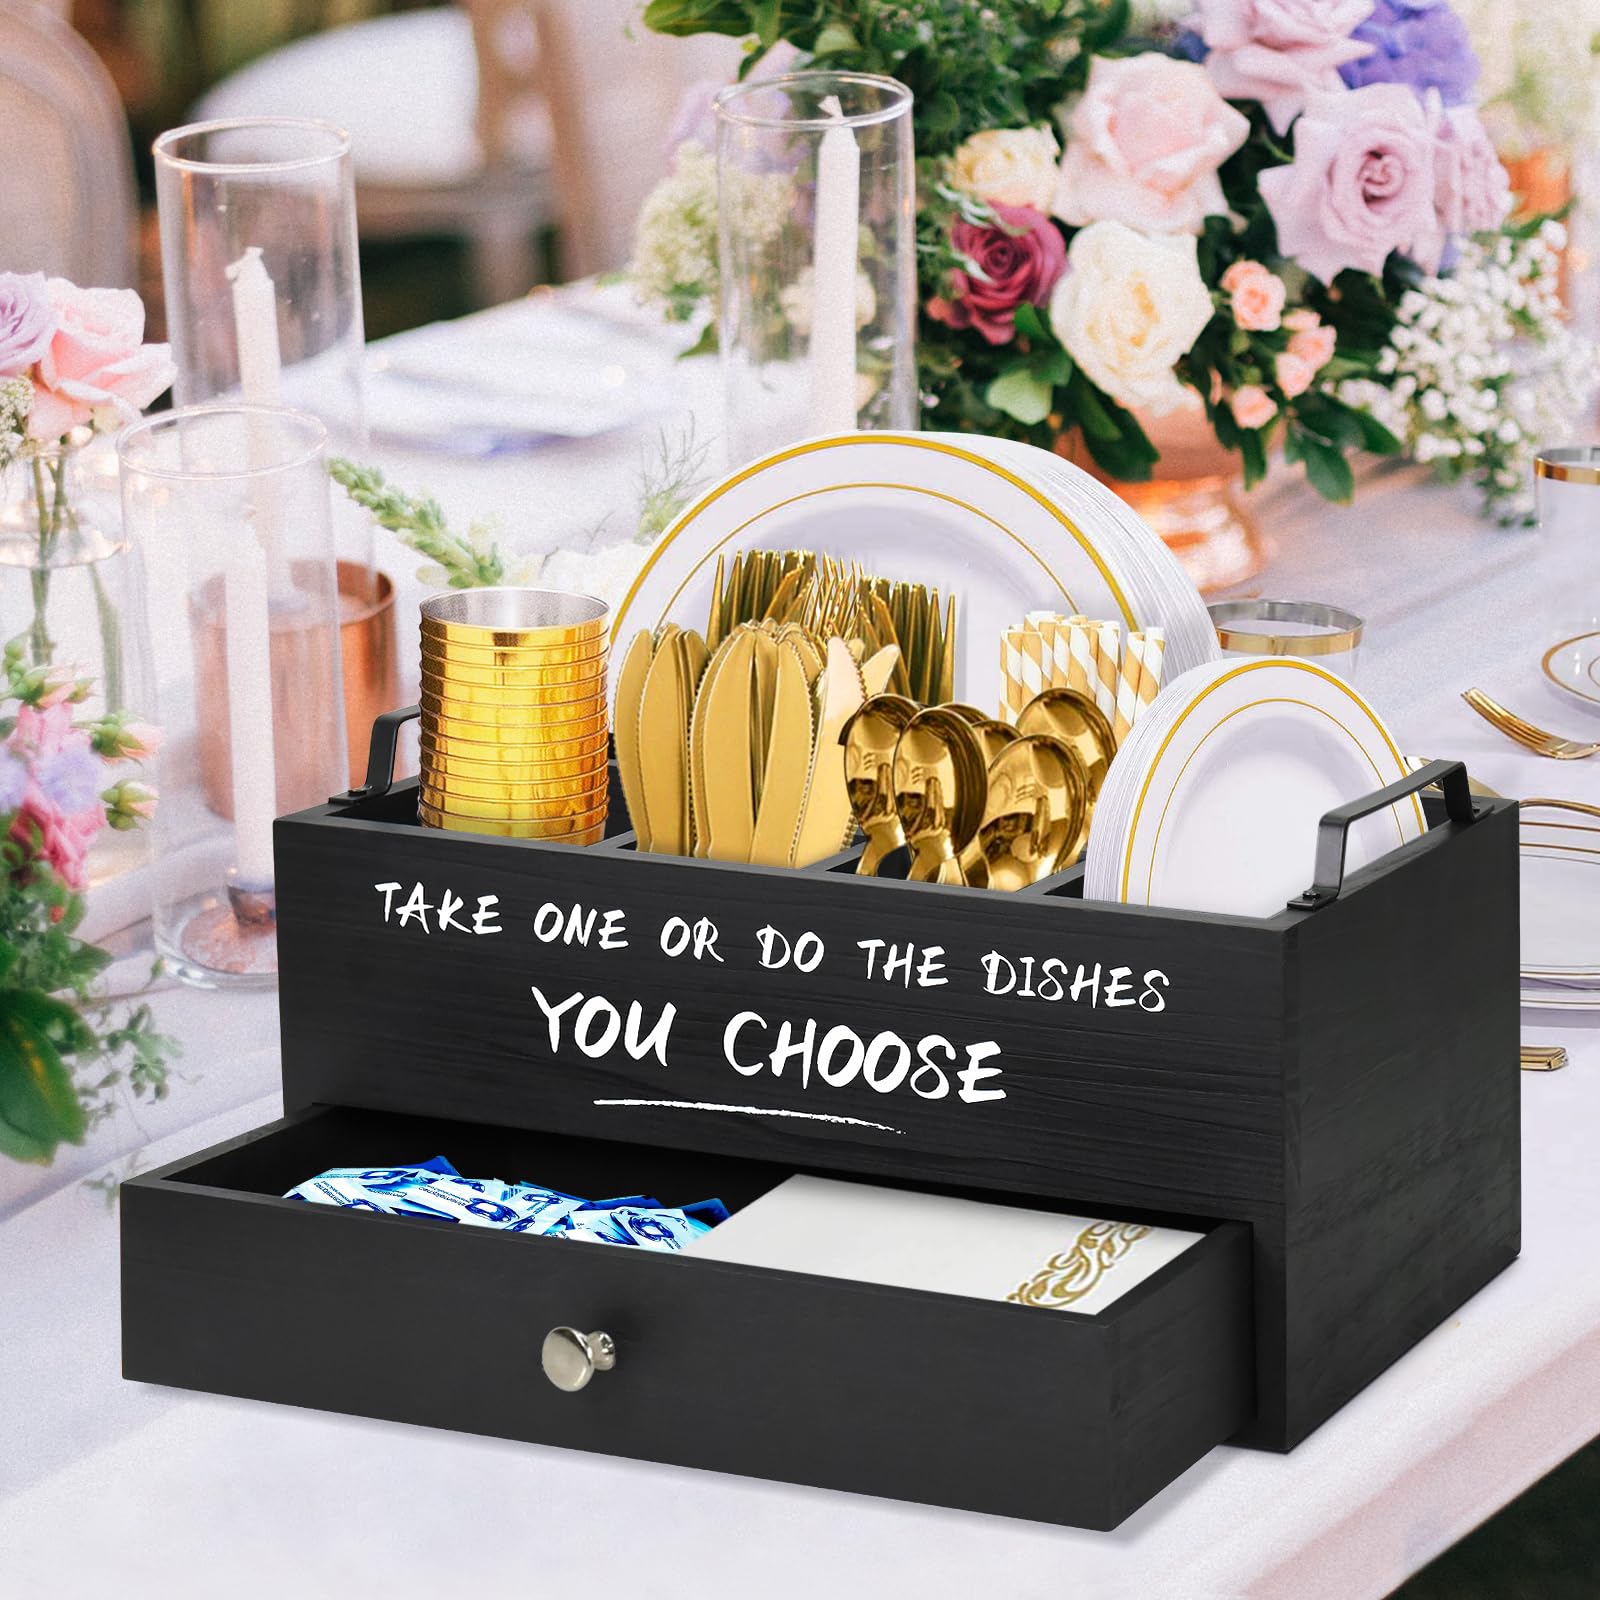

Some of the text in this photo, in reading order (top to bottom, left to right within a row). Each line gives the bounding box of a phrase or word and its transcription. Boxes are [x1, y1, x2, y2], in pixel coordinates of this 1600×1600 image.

[375, 882, 1169, 1012] TAKE ONE OR DO THE DISHES
[531, 986, 1006, 1104] YOU CHOOSE
